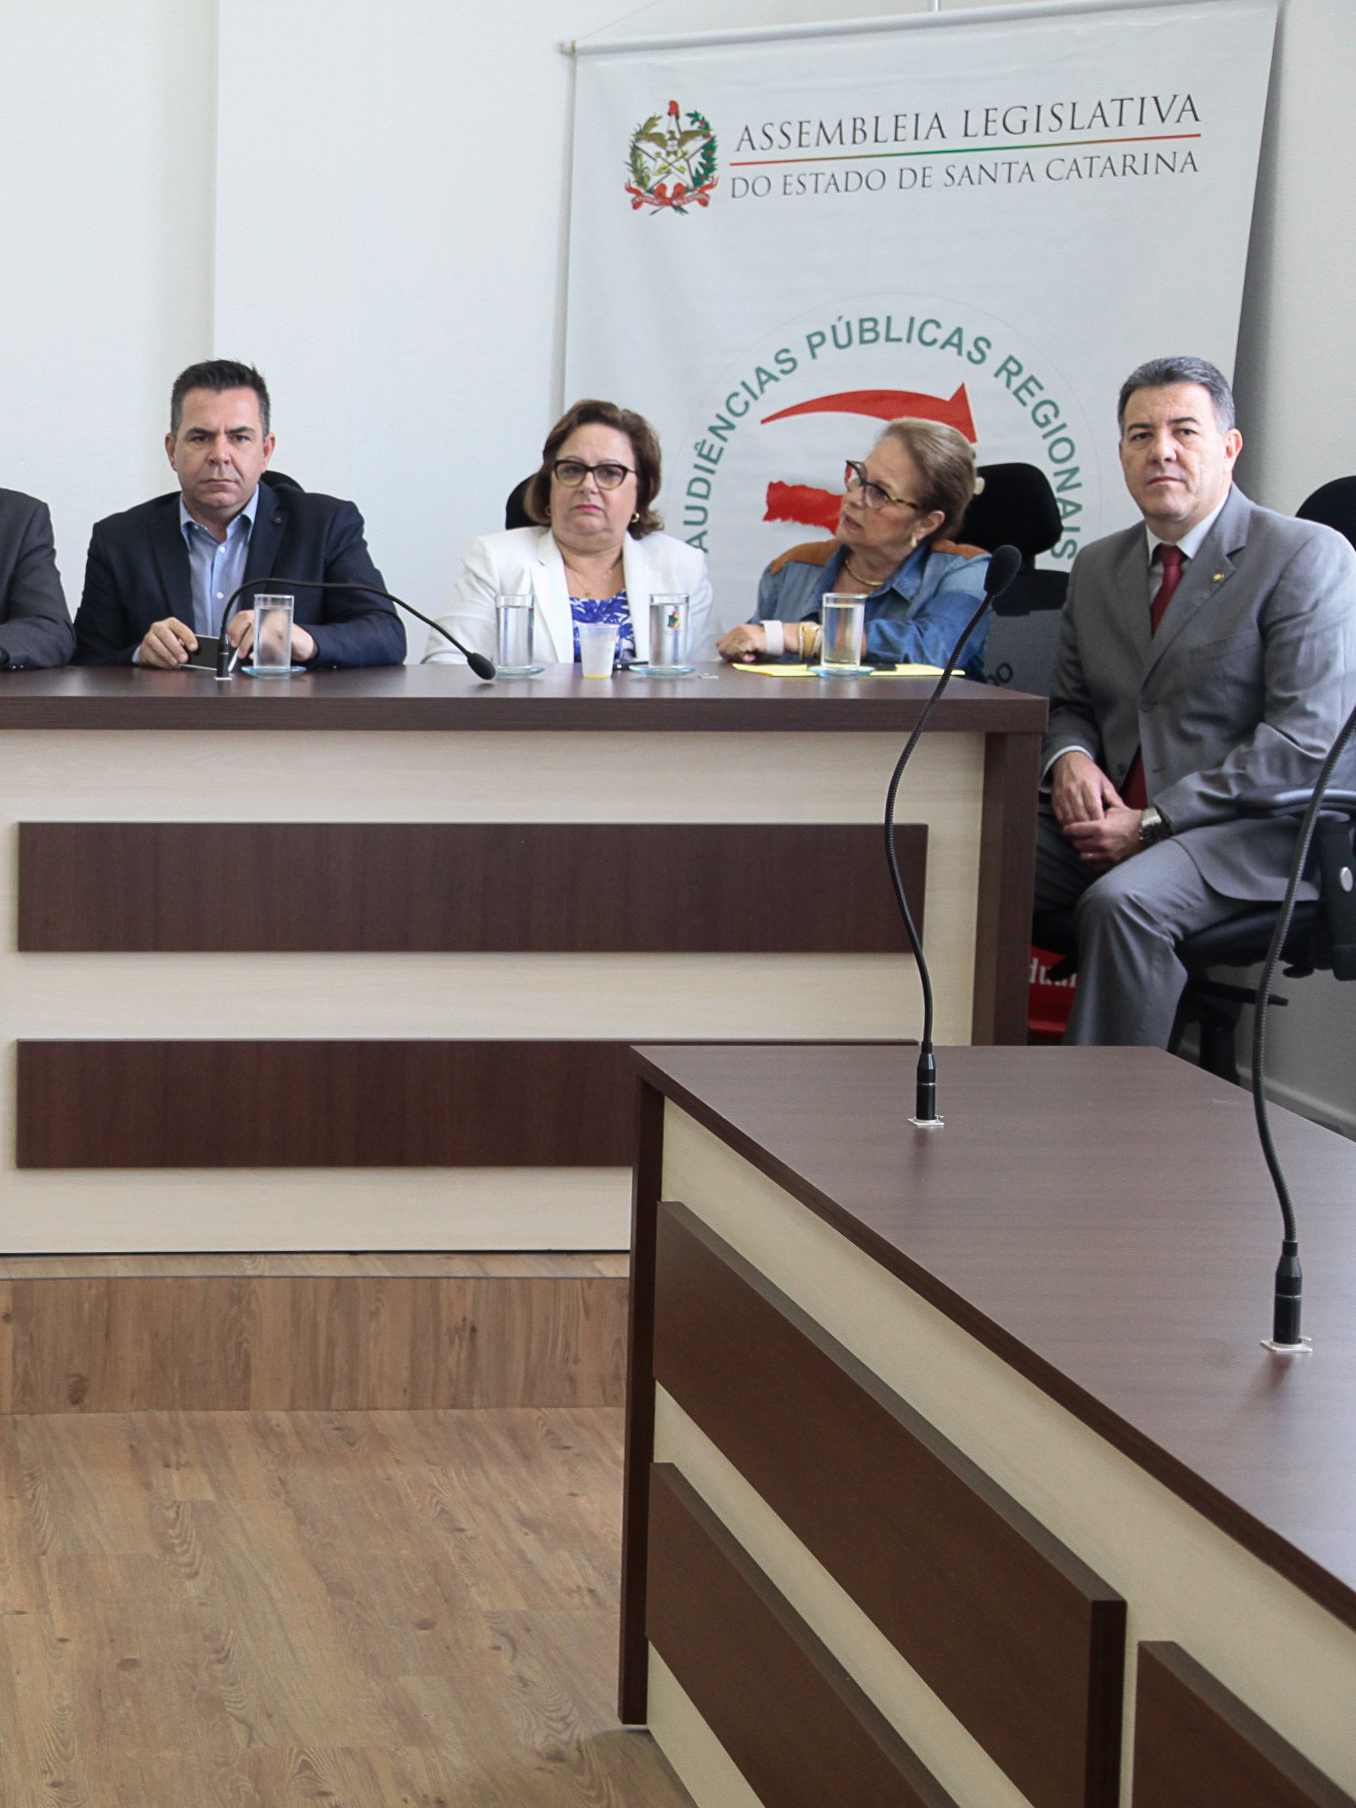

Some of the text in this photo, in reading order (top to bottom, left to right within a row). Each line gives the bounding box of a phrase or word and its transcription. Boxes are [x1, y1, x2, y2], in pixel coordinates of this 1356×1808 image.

[735, 93, 1202, 152] ASSEMBLEIA LEGISLATIVA
[730, 150, 1200, 199] DO ESTADO DE SANTA CATARINA
[683, 315, 1084, 560] AUDIÊNCIAS PÚBLICAS REGIONAIS
